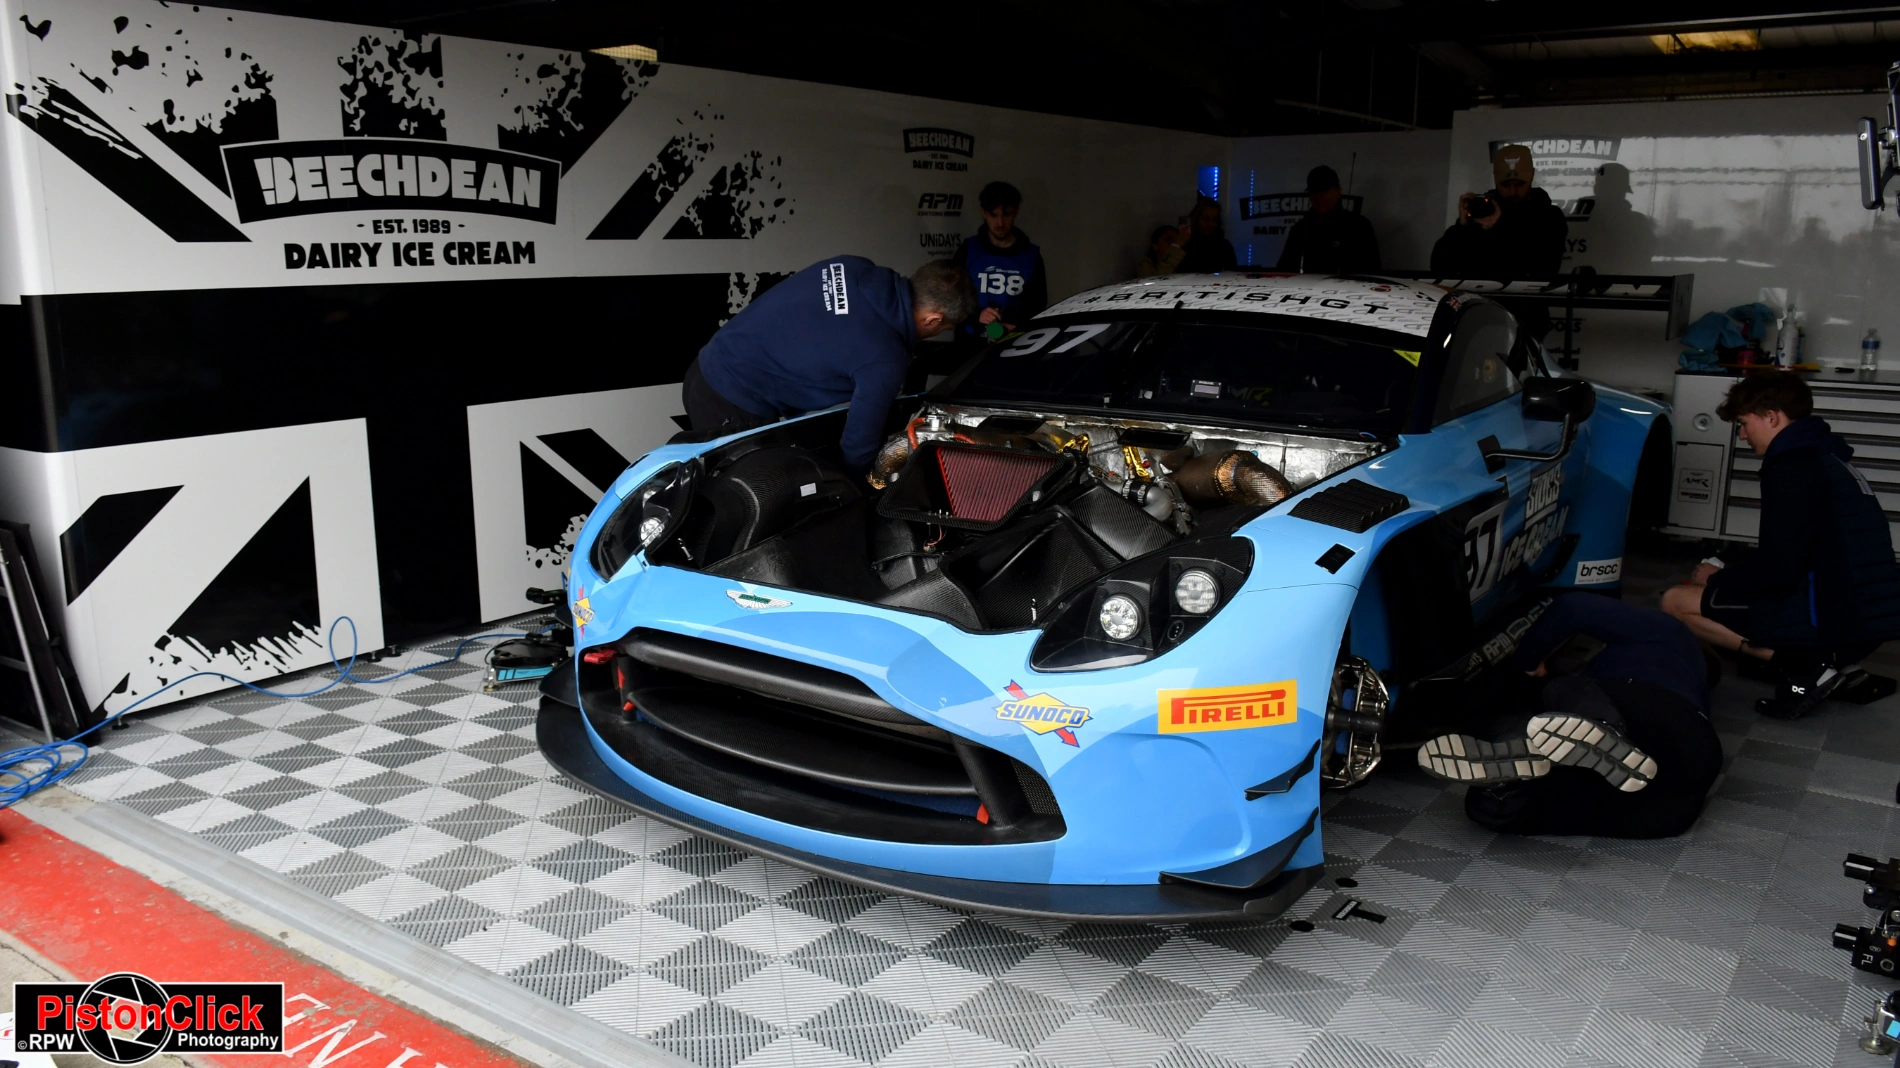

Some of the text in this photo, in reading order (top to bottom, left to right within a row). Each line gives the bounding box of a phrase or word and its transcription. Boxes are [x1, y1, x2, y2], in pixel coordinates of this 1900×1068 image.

[908, 131, 971, 153] BEECHDEAN
[1498, 139, 1612, 156] CHDEAN
[913, 159, 968, 172] DAIRY ICE CREAM
[254, 153, 542, 209] BEECHDEAN
[918, 193, 963, 210] APM
[373, 218, 452, 234] EST. 1989
[1254, 226, 1287, 235] DAIRY
[284, 240, 536, 270] DAIRY ICE CREAM
[832, 264, 846, 310] BEECHDEAN
[978, 272, 1025, 297] 138
[1083, 290, 1390, 315] #BRITISHGT
[998, 324, 1113, 358] 97
[1580, 563, 1618, 577] brscc
[999, 702, 1087, 726] SUNOCO
[1171, 688, 1287, 725] PIRELLI
[1861, 952, 1874, 966] FL
